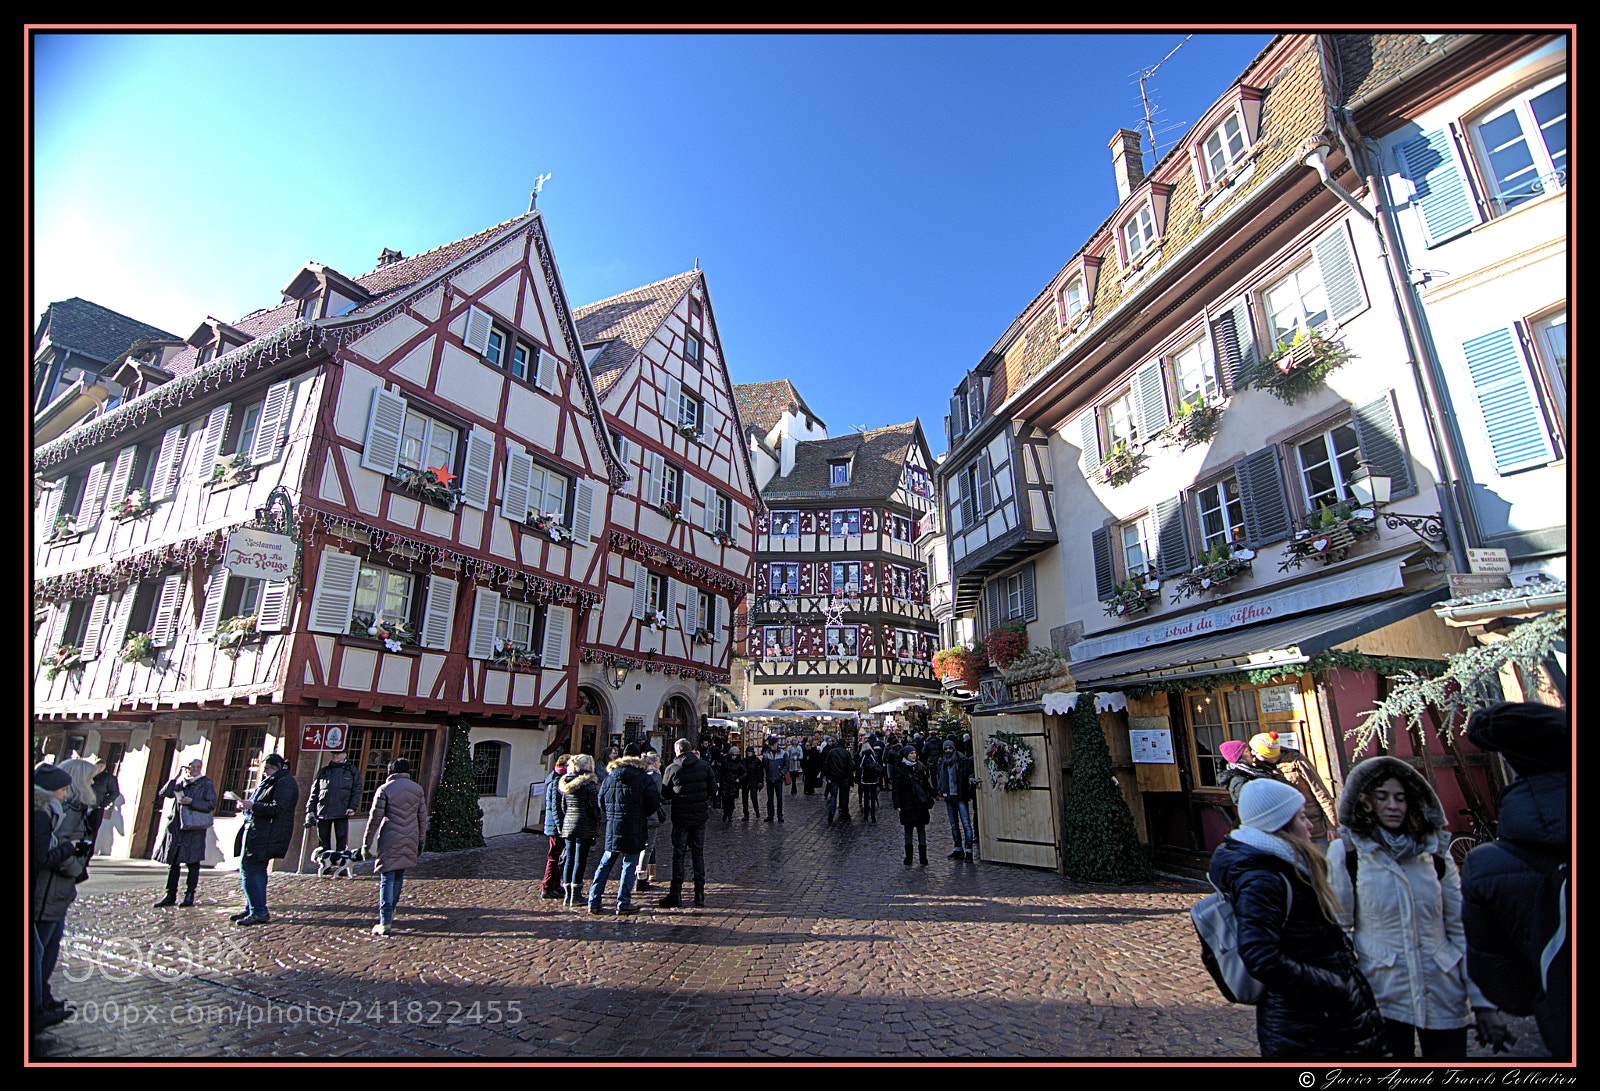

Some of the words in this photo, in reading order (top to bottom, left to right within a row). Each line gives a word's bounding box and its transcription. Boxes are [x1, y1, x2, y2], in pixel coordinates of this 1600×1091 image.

[245, 538, 282, 551] Restaurant
[229, 549, 254, 566] Fer
[253, 552, 290, 573] Rouge
[1197, 618, 1213, 631] du
[762, 688, 774, 696] au
[819, 685, 855, 698] pignon
